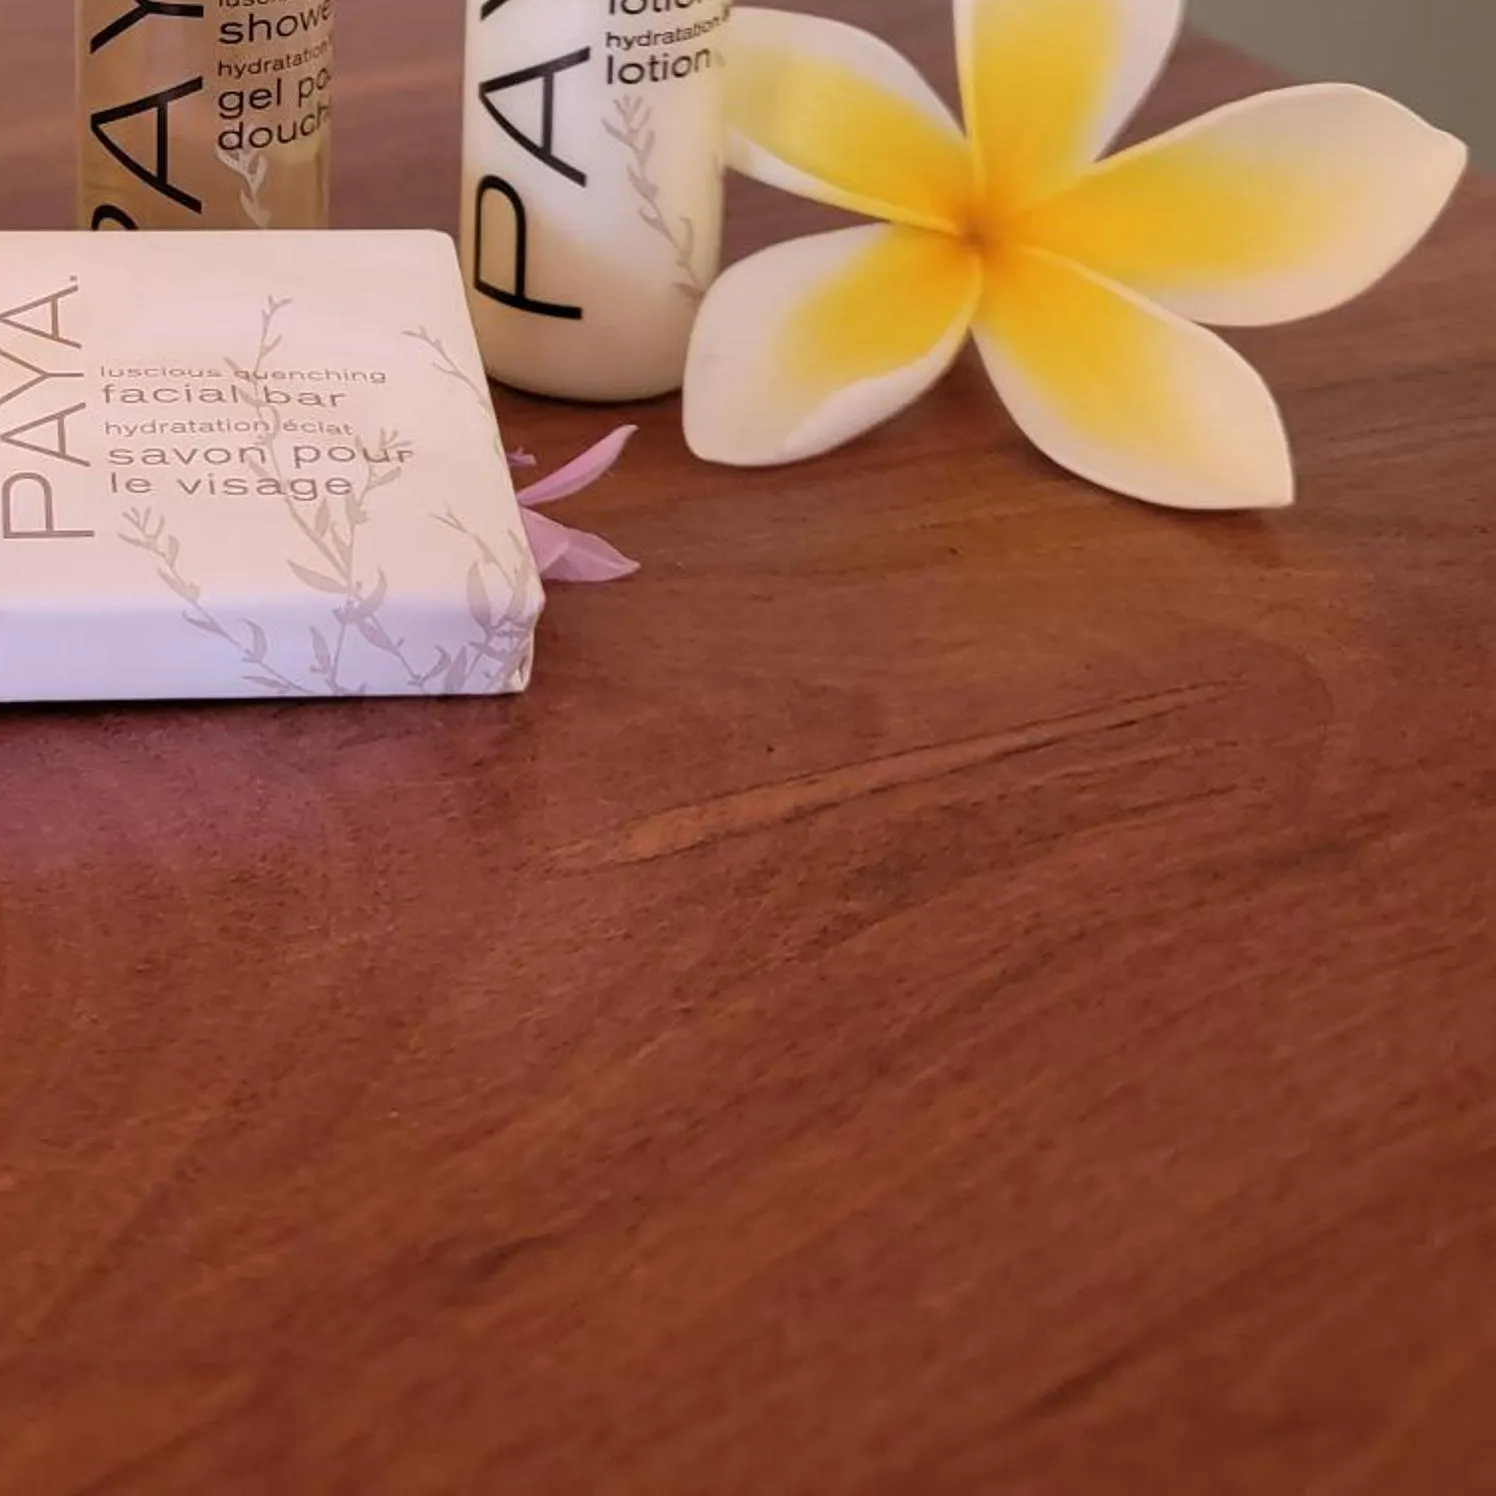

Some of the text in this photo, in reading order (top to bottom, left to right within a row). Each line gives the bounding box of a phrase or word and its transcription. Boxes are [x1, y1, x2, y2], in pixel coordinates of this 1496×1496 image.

[605, 17, 720, 51] hydratation
[217, 39, 328, 80] hydratation
[606, 48, 711, 84] lotion
[217, 78, 282, 120] gel
[100, 365, 386, 384] luscious quenching
[102, 384, 347, 408] facial bar
[105, 418, 355, 438] hydratation éclat
[107, 445, 416, 469] savon pour
[110, 472, 353, 502] le visage
